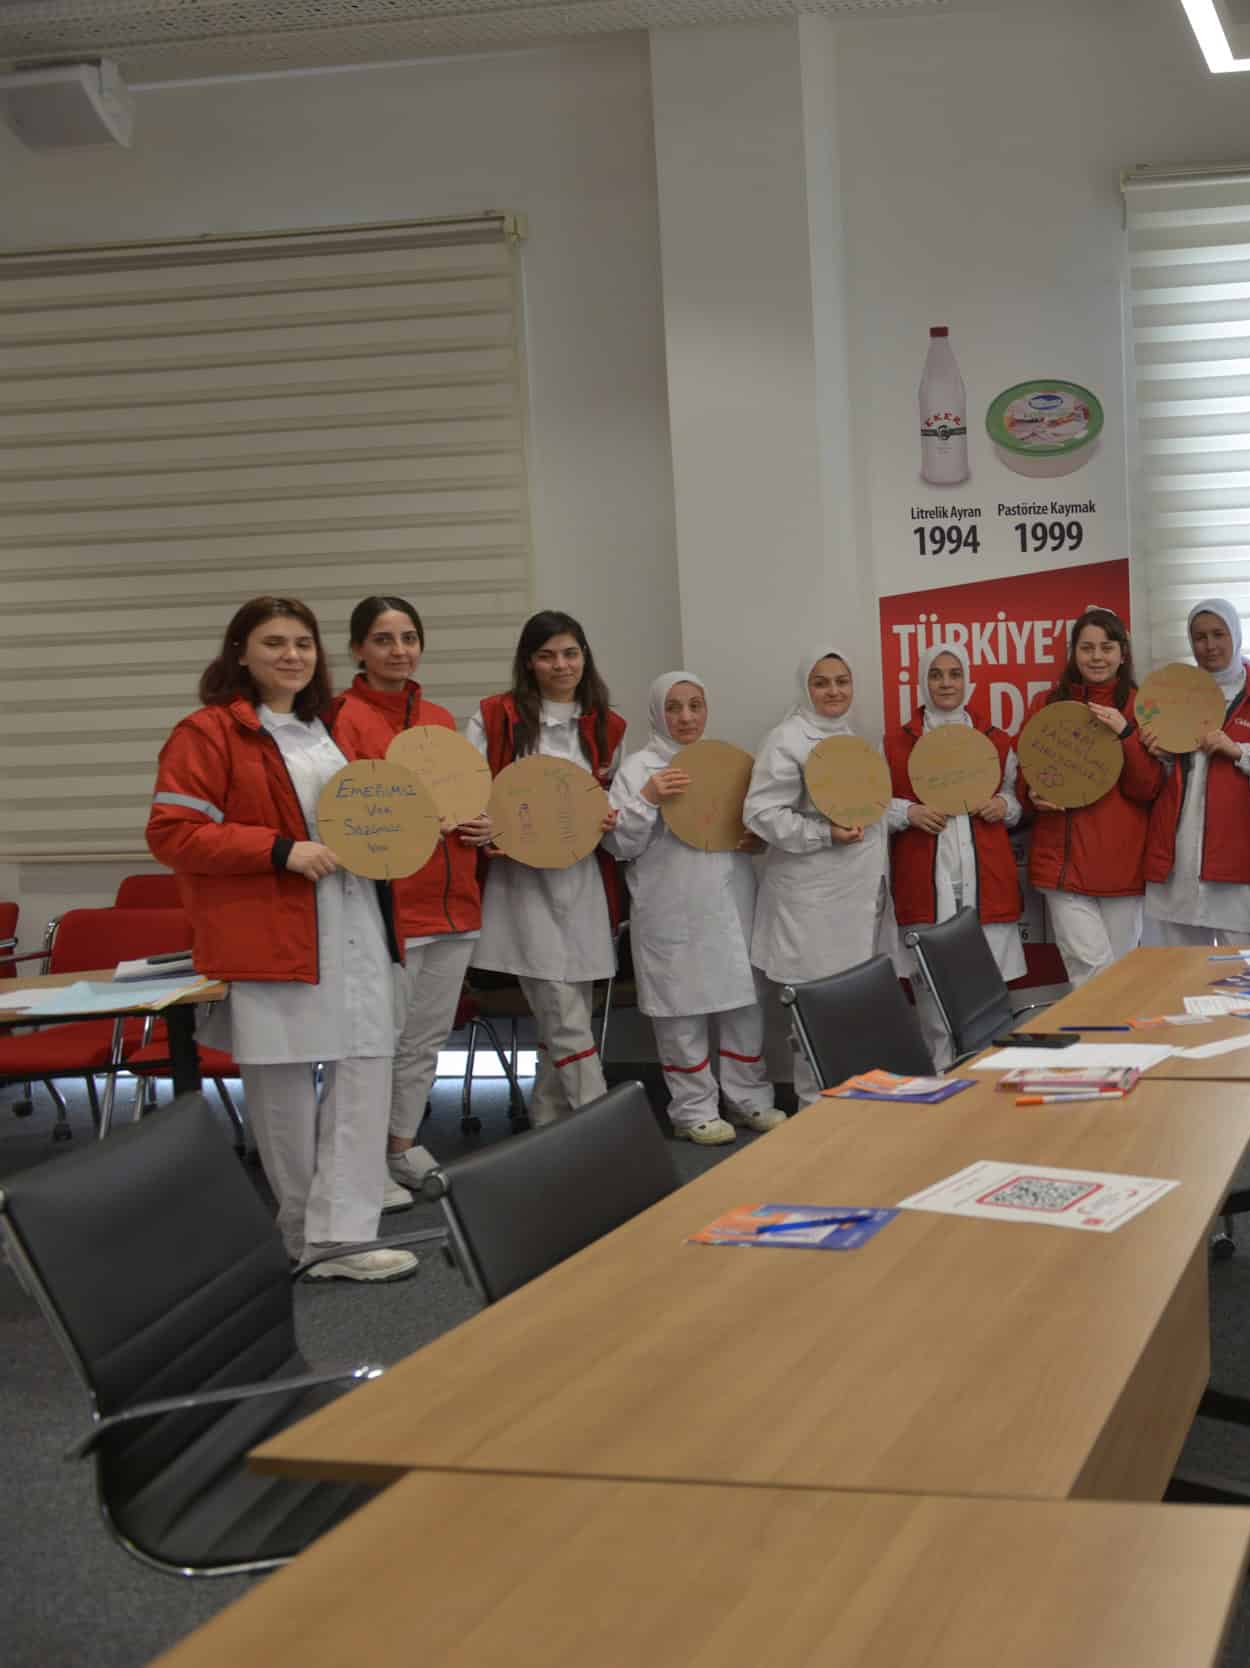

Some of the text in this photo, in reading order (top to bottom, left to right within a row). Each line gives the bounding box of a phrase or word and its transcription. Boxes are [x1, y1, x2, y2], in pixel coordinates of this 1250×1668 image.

[911, 506, 982, 521] Litrelik Ayran
[997, 500, 1096, 517] Pastörize Kaymak
[913, 524, 981, 556] 1994
[1014, 520, 1083, 553] 1999
[892, 611, 1076, 668] TÜRKİYE'
